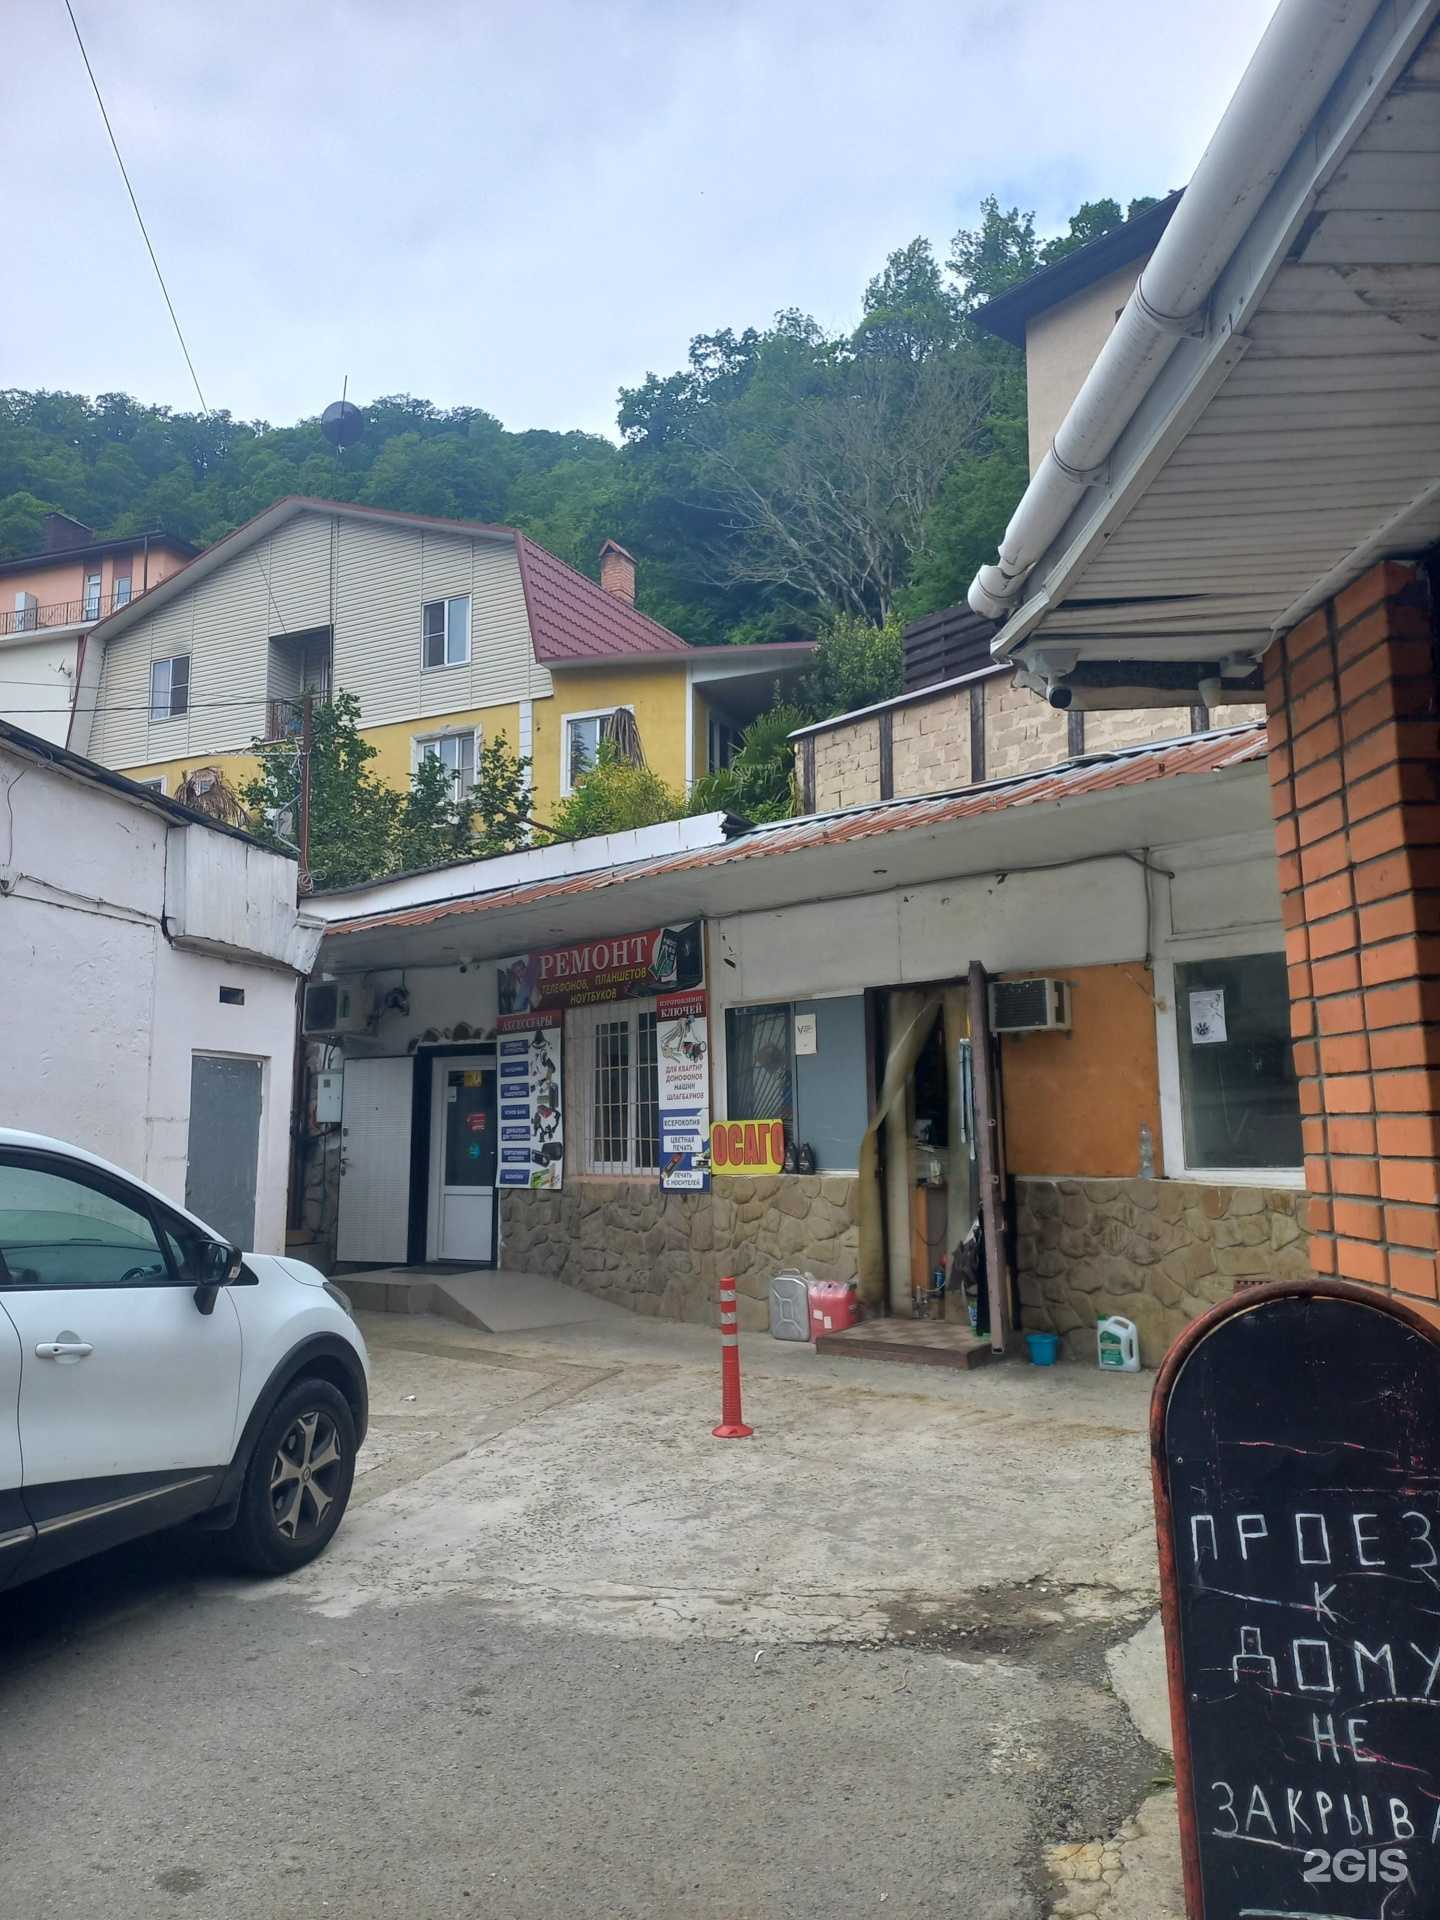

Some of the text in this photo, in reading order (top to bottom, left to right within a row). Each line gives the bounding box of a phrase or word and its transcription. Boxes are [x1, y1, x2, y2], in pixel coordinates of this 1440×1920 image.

[539, 936, 648, 979] РЕМОНТ
[594, 967, 647, 985] ПЛАНШЕТОВ
[570, 988, 617, 1005] НОУТБУКОВ
[661, 1002, 702, 1018] КЛЮЧЕЙ
[712, 1122, 784, 1166] ОСАГО
[1190, 1511, 1438, 1567] ПРОЕЗ
[1313, 1581, 1337, 1623] К
[1232, 1626, 1440, 1697] ДОМУ
[1312, 1713, 1377, 1765] НЕ
